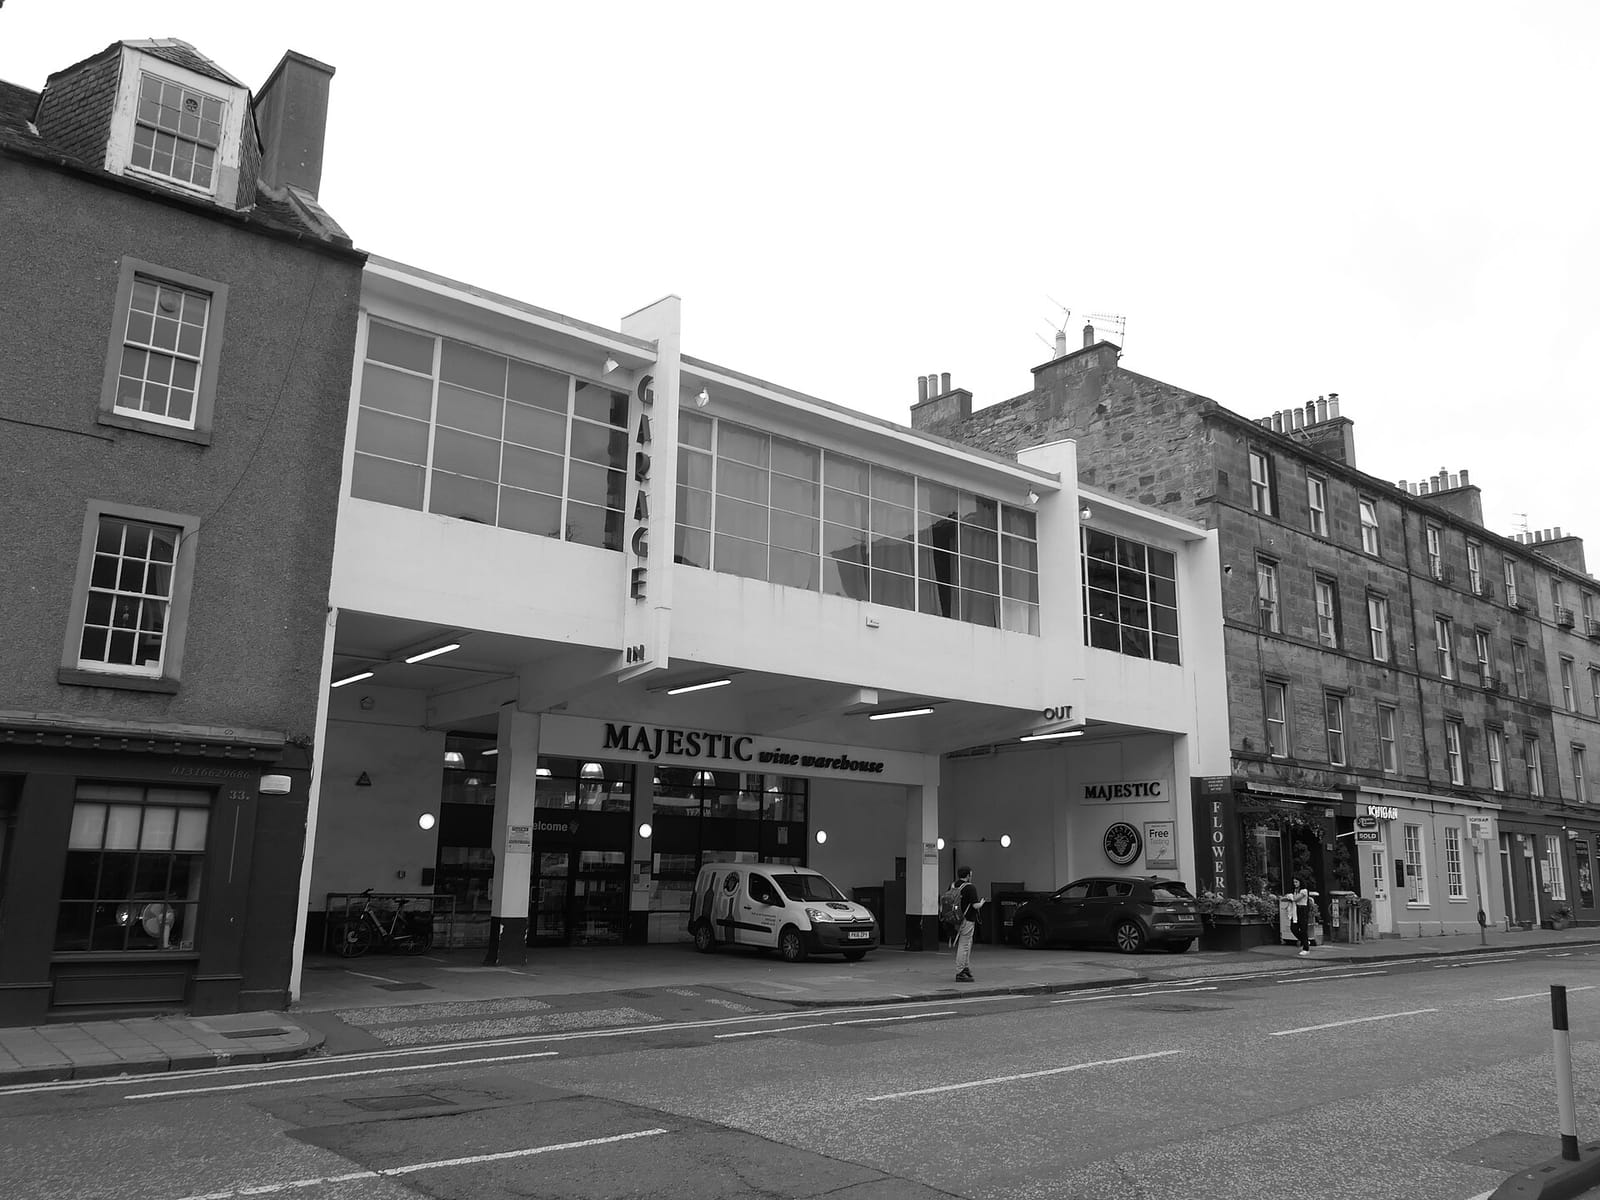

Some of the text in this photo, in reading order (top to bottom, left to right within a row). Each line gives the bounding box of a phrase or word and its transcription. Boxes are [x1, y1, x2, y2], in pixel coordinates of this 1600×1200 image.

[630, 375, 654, 600] GARAGE
[626, 644, 645, 663] IN
[1043, 705, 1073, 720] OUT
[603, 722, 884, 774] MAJESTIC wine warehouse
[1084, 781, 1161, 802] MAJESTIC
[533, 820, 568, 832] elcome
[1149, 829, 1169, 838] Free
[1211, 801, 1225, 899] FLOWERS
